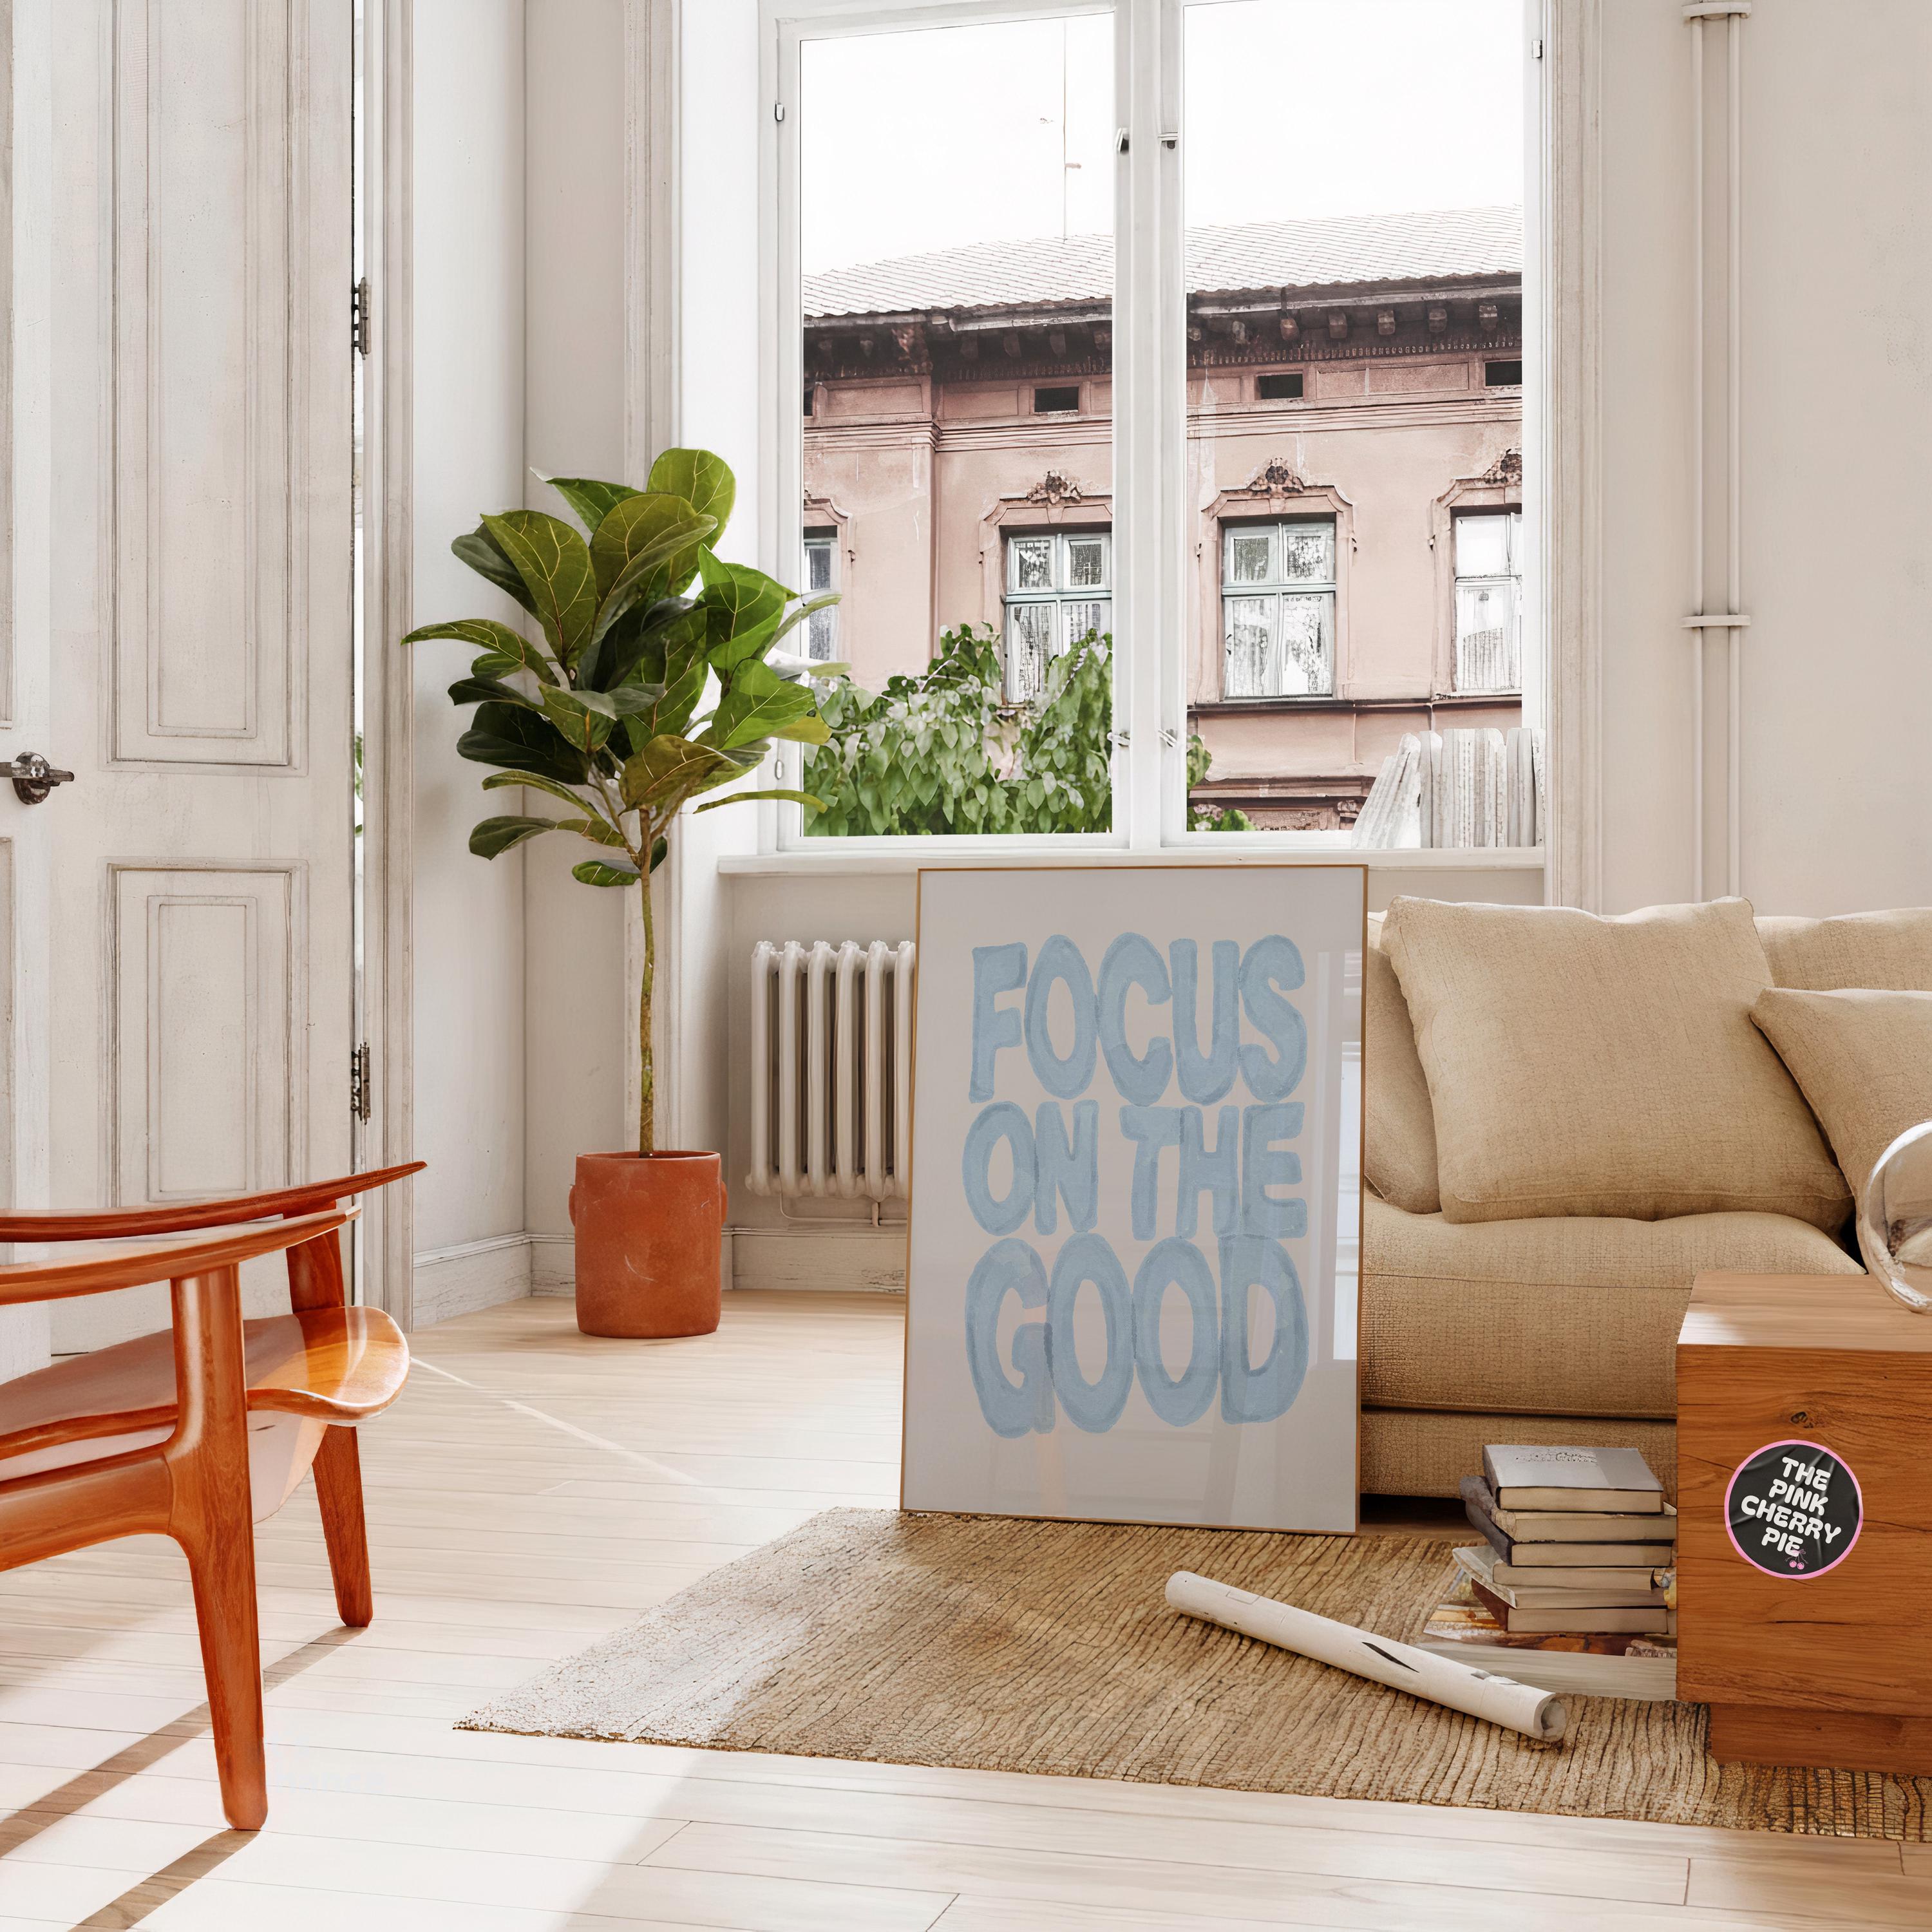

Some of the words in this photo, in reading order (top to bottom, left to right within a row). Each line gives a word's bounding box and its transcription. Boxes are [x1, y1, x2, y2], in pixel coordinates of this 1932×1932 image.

[968, 932, 1308, 1107] FOCUS
[961, 1100, 1099, 1236] ON
[1119, 1101, 1308, 1242] THE
[965, 1231, 1310, 1439] GOOD
